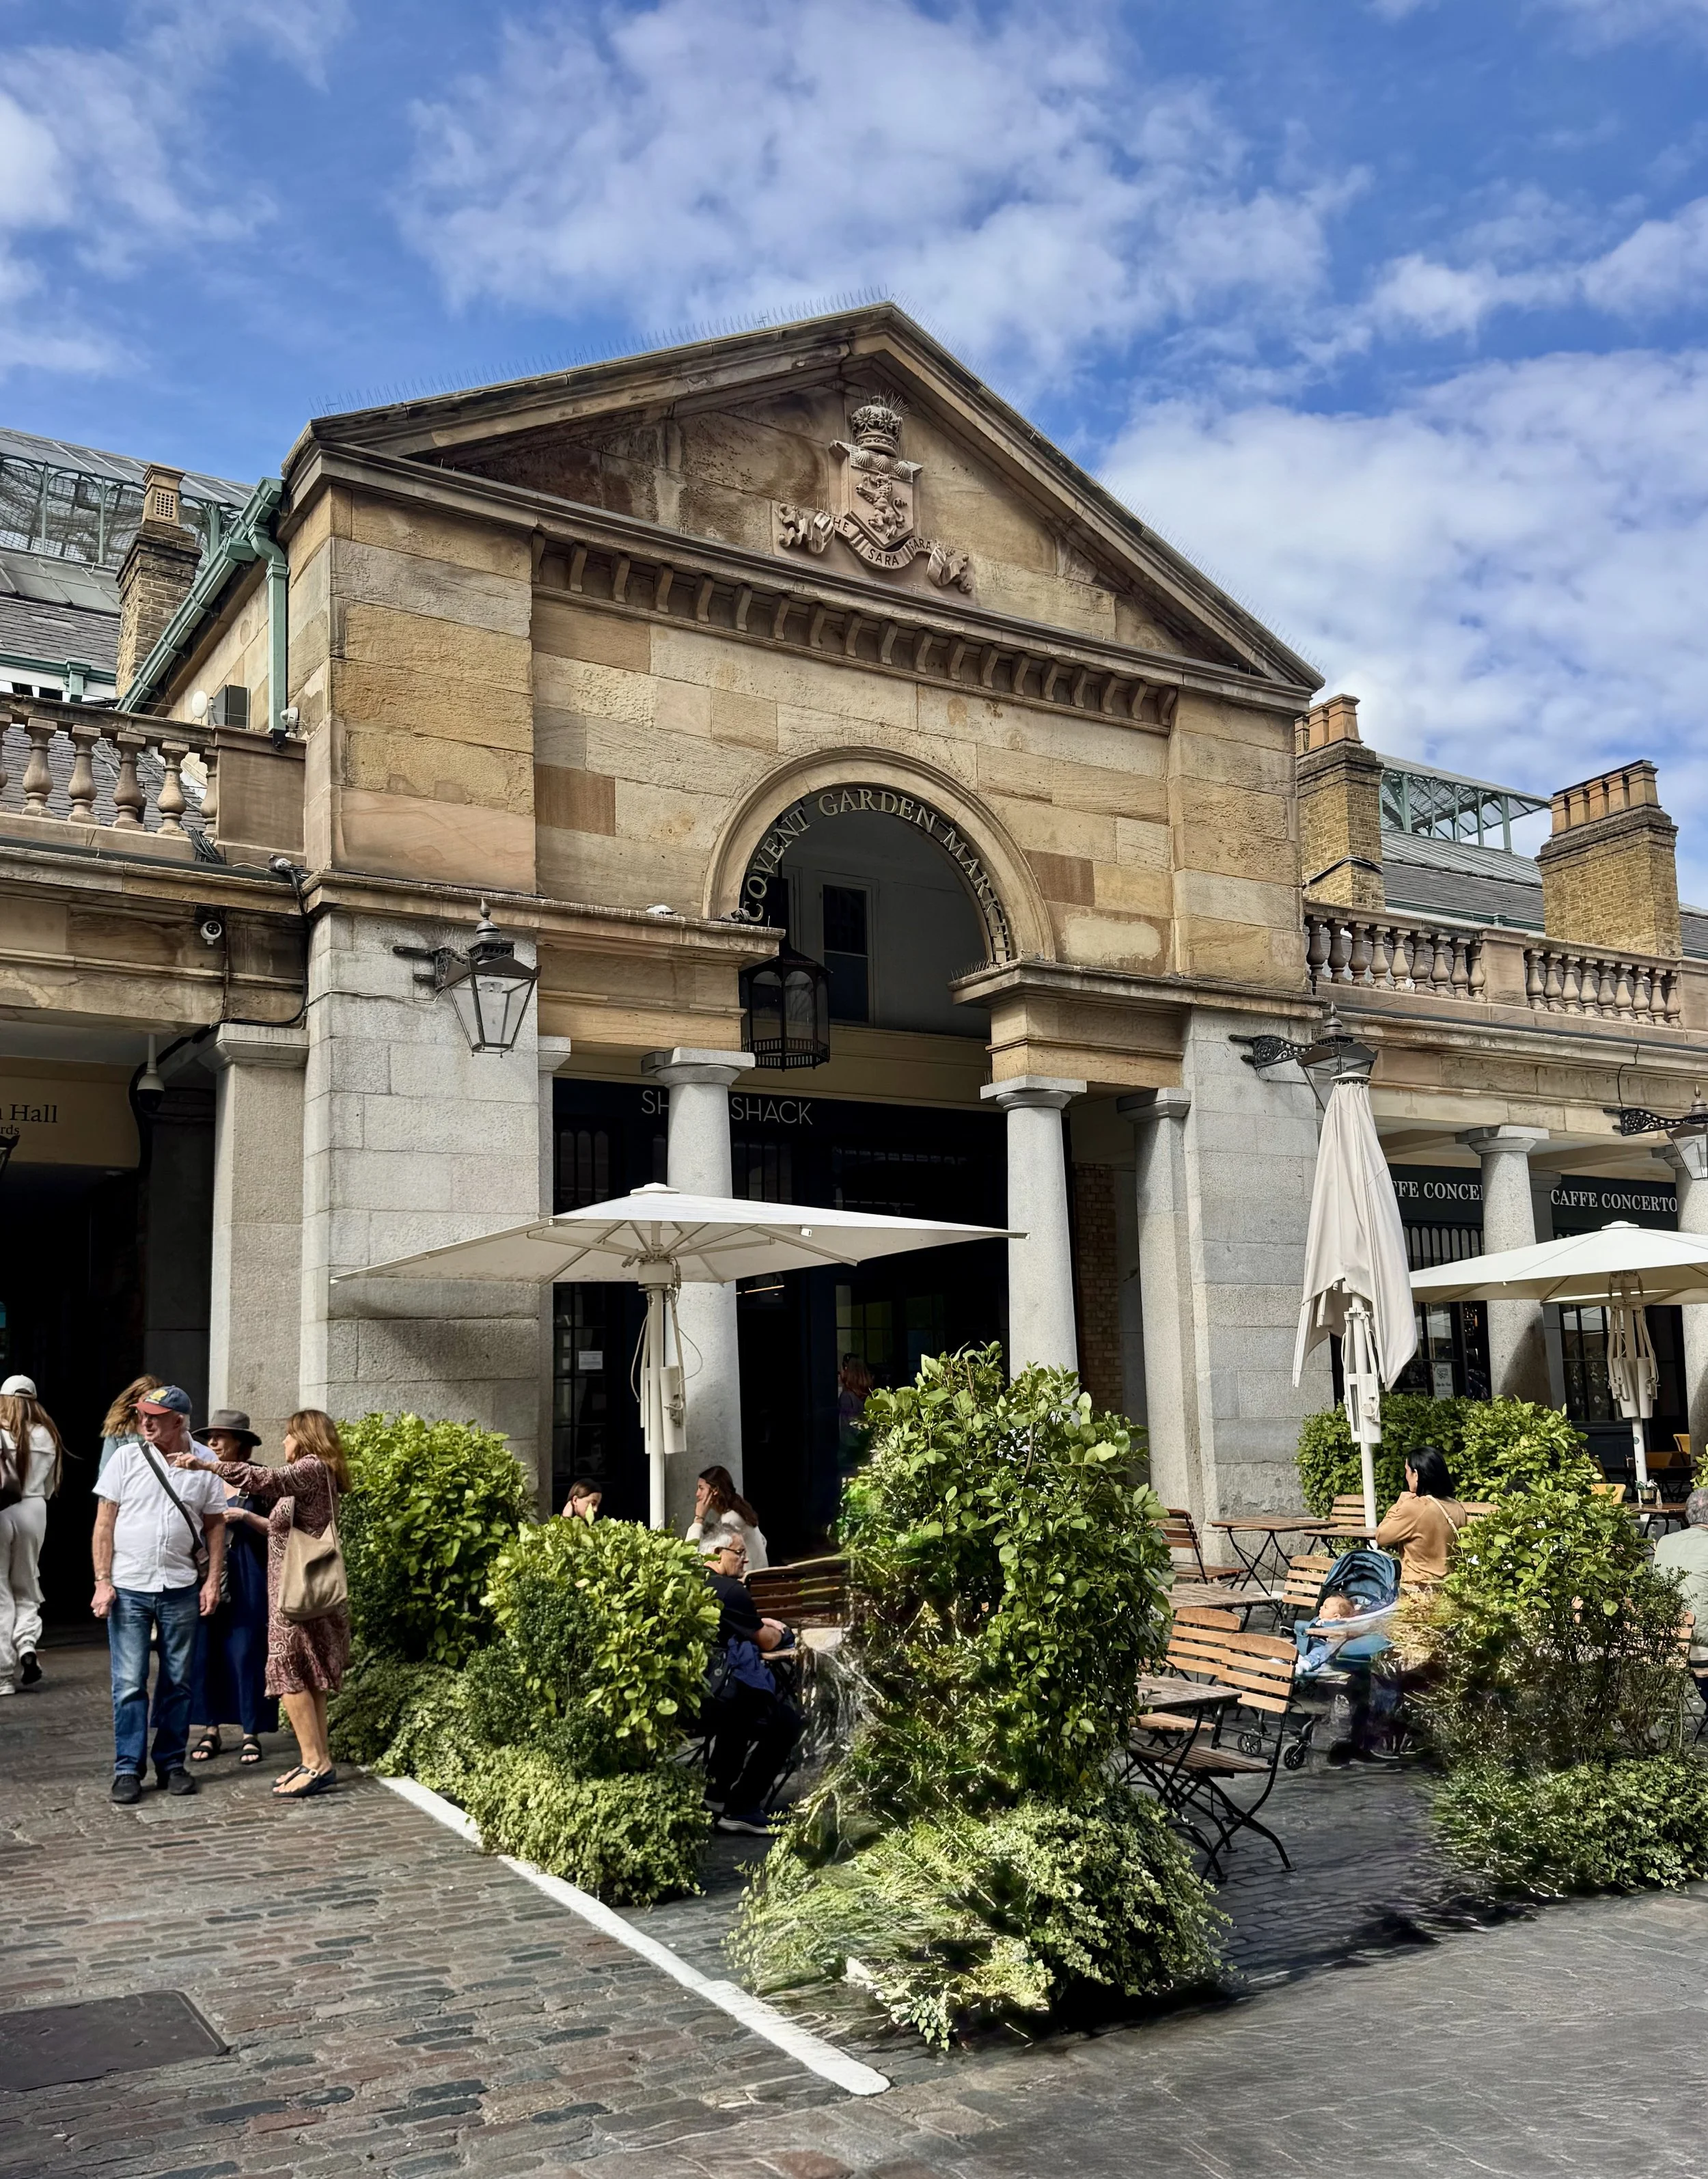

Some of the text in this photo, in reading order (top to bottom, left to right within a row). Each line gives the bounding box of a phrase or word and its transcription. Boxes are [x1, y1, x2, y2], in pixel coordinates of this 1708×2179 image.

[829, 516, 849, 532] HE
[868, 549, 899, 566] SARA
[743, 789, 1011, 961] COVENT GARDEN MARKET
[9, 1104, 58, 1123] Hall
[731, 1097, 813, 1125] SHACK
[1423, 1182, 1483, 1201] CONCE
[1550, 1189, 1677, 1212] CAFFE CONCERTO
